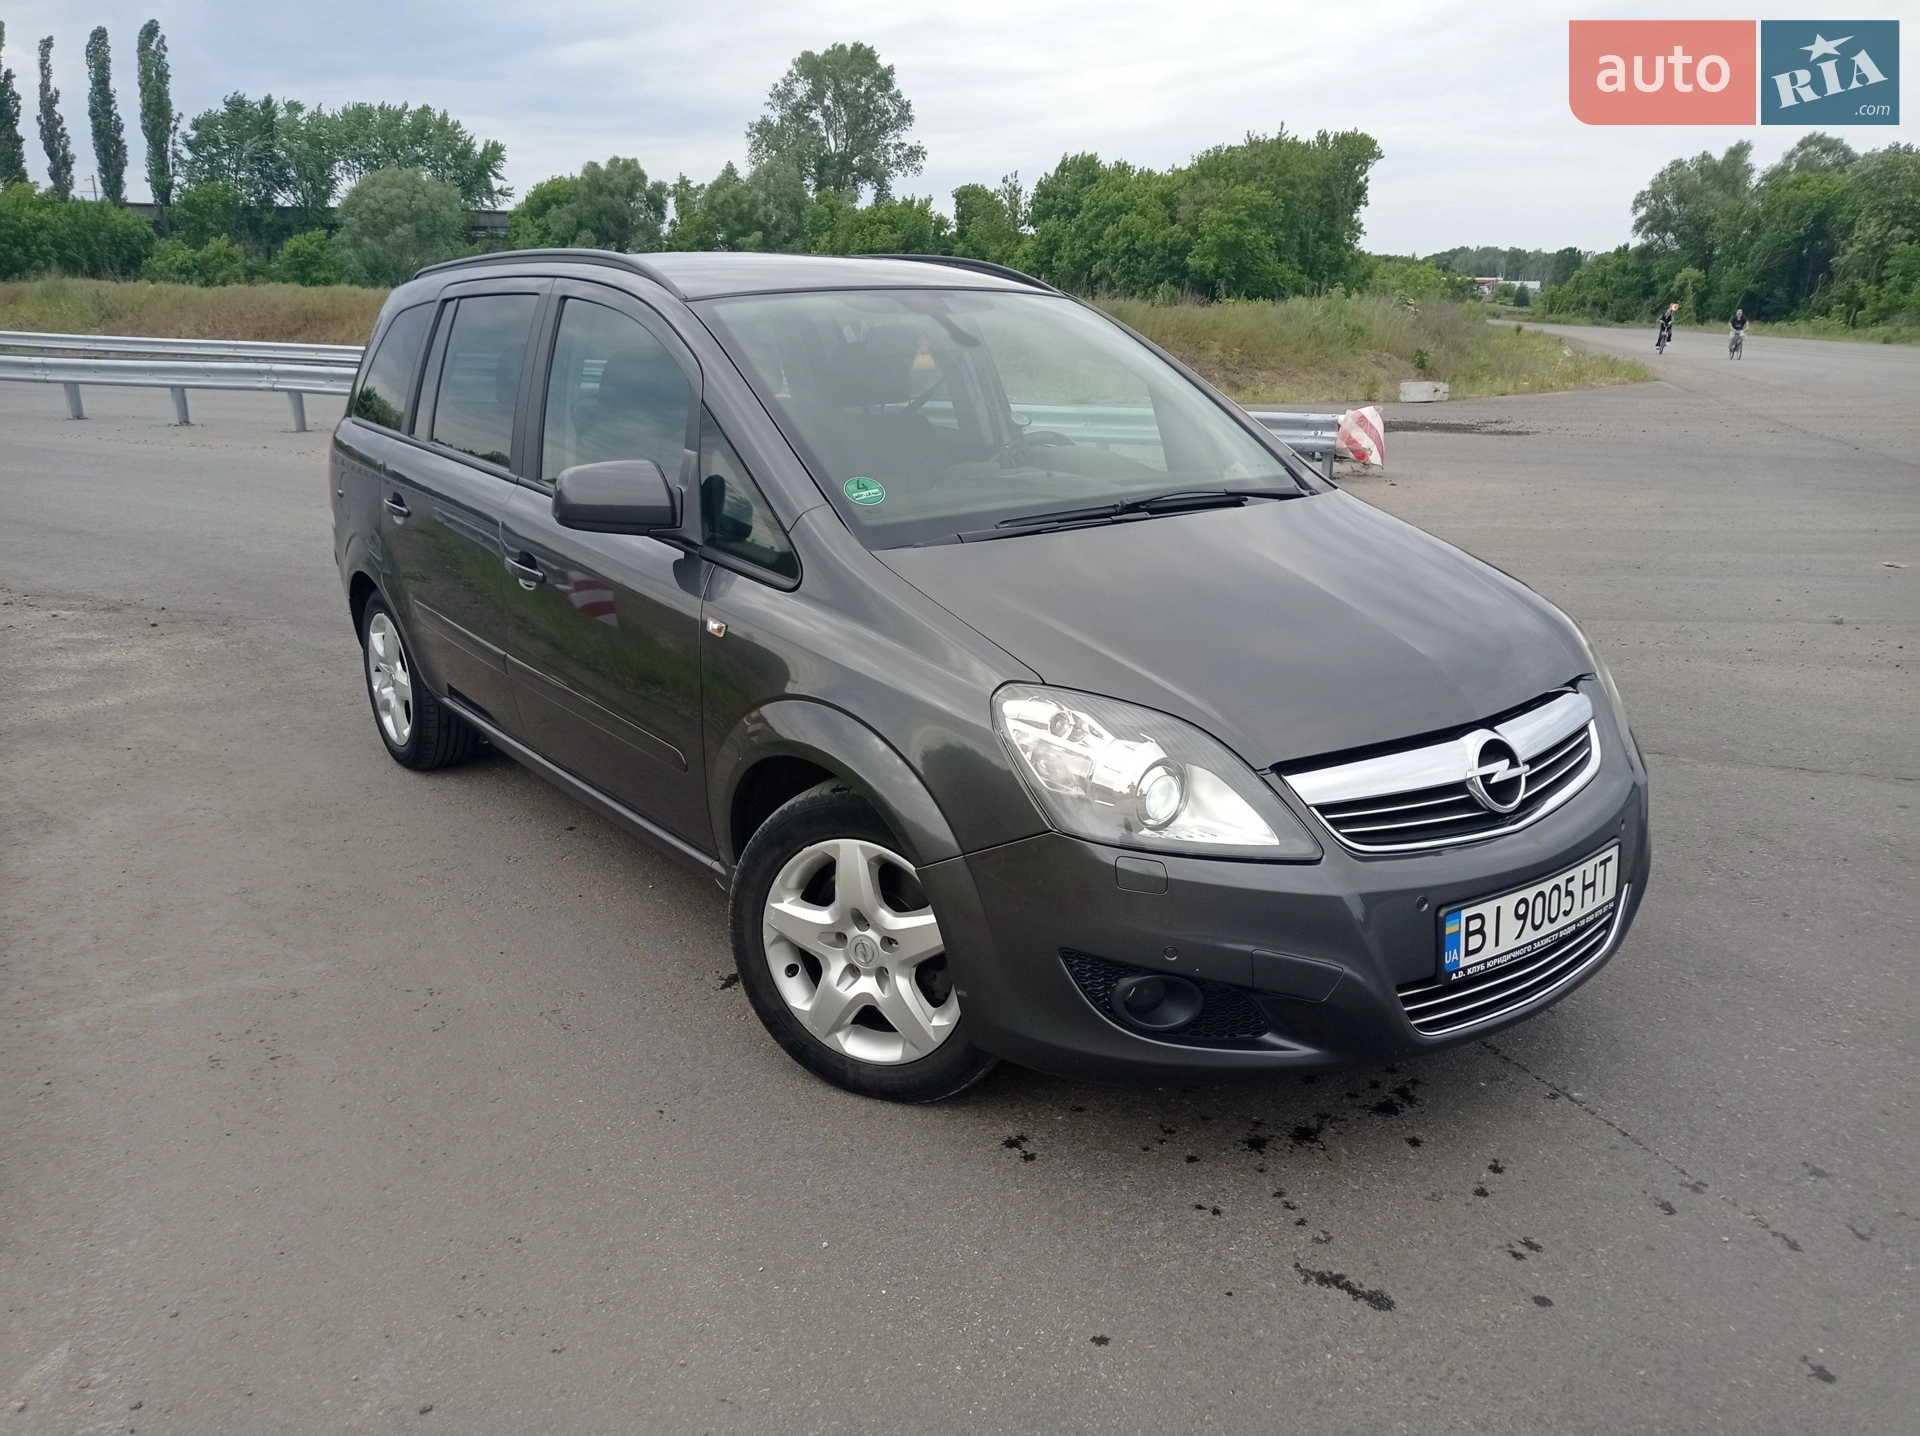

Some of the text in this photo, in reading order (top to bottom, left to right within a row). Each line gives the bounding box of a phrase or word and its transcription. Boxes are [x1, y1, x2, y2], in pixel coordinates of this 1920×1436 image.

[1464, 855, 1613, 957] BI 9005 HT
[1445, 949, 1459, 964] UA
[1467, 963, 1485, 975] КЛУБ
[1487, 944, 1532, 968] ЮРИДИЧНОГО
[1533, 933, 1559, 950] ЗАХИСТУ
